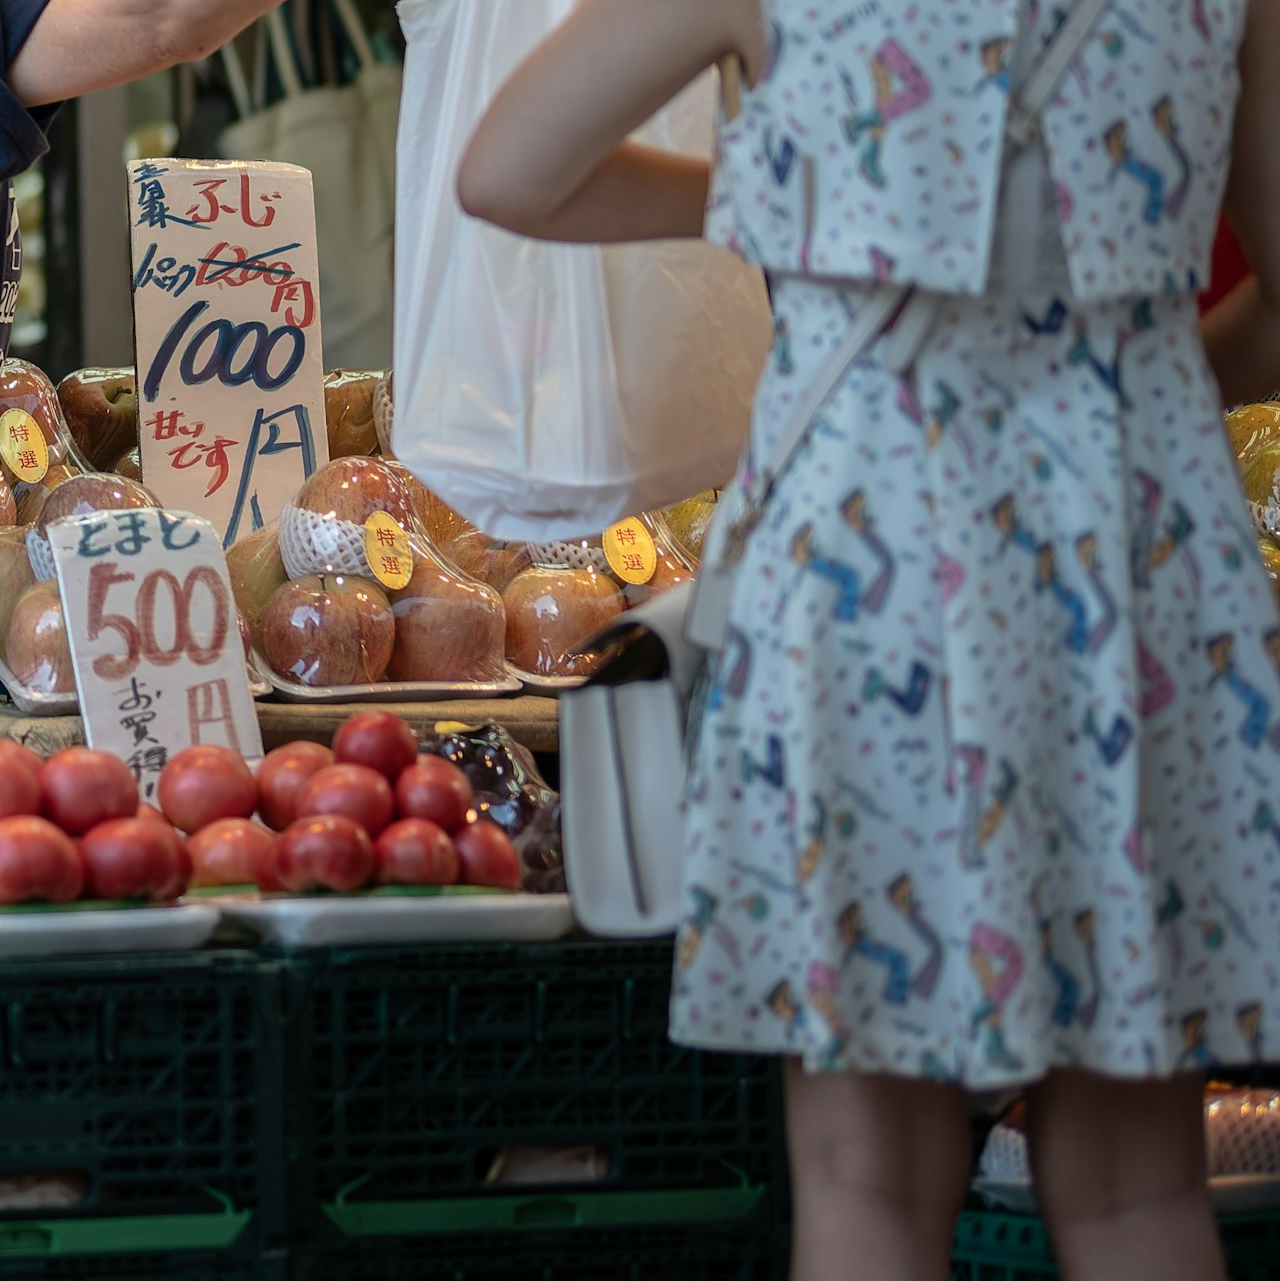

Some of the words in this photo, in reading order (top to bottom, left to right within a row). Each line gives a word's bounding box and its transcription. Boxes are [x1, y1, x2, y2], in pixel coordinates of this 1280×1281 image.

[185, 168, 282, 228] ふじ
[270, 277, 317, 330] 円
[143, 300, 306, 403] 1000
[8, 423, 40, 470] 特選
[167, 434, 240, 498] です
[77, 509, 202, 558] とまと
[376, 526, 403, 576] 特選
[615, 526, 646, 573] 特選
[86, 559, 231, 681] 500
[185, 677, 242, 752] 円
